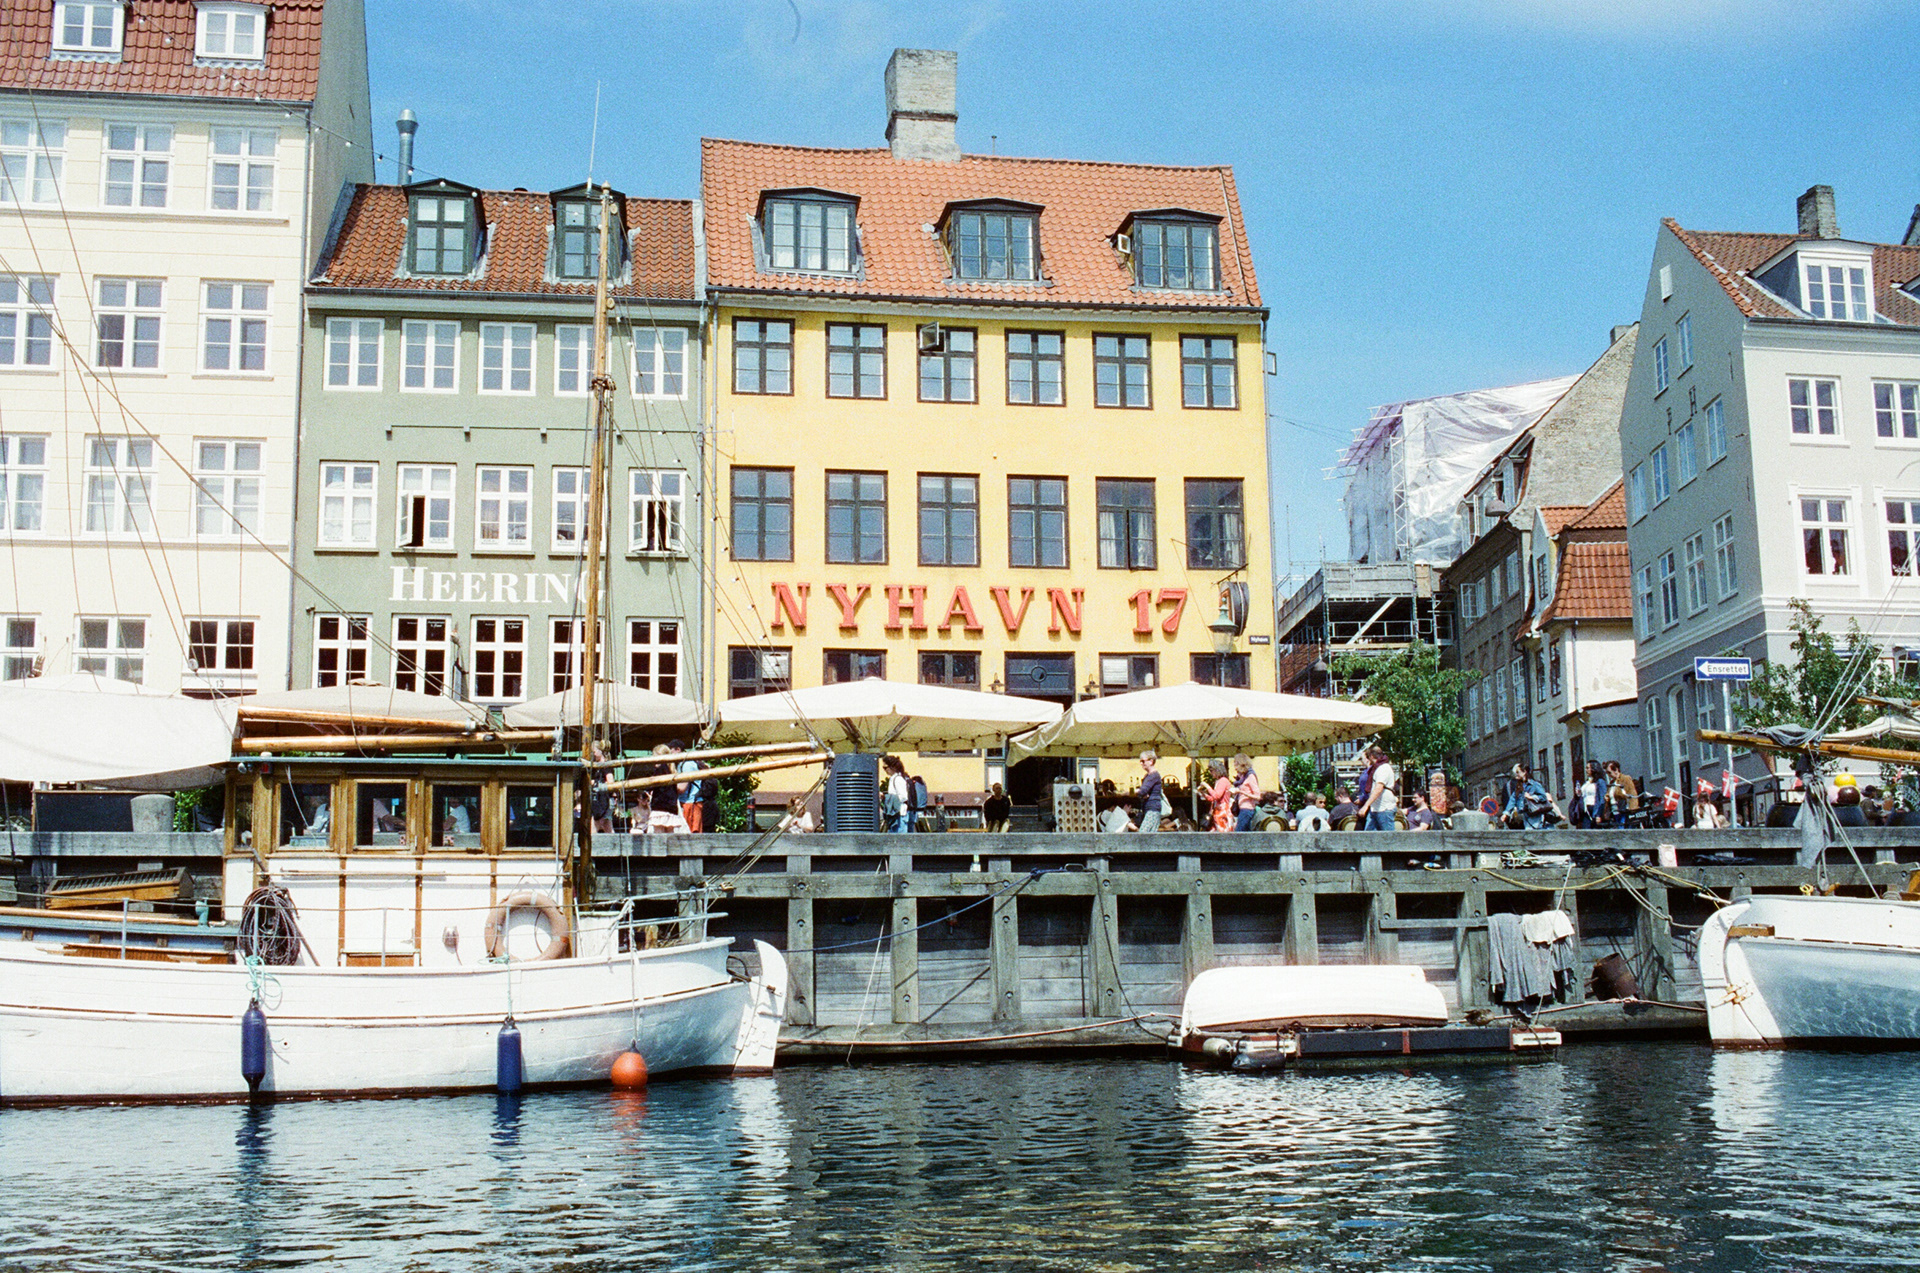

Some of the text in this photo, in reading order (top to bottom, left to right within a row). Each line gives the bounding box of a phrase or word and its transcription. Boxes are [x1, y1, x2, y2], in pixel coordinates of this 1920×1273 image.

[771, 581, 1189, 634] NYHAVN 17
[1707, 665, 1747, 673] Ensrettet
[216, 679, 225, 688] 13
